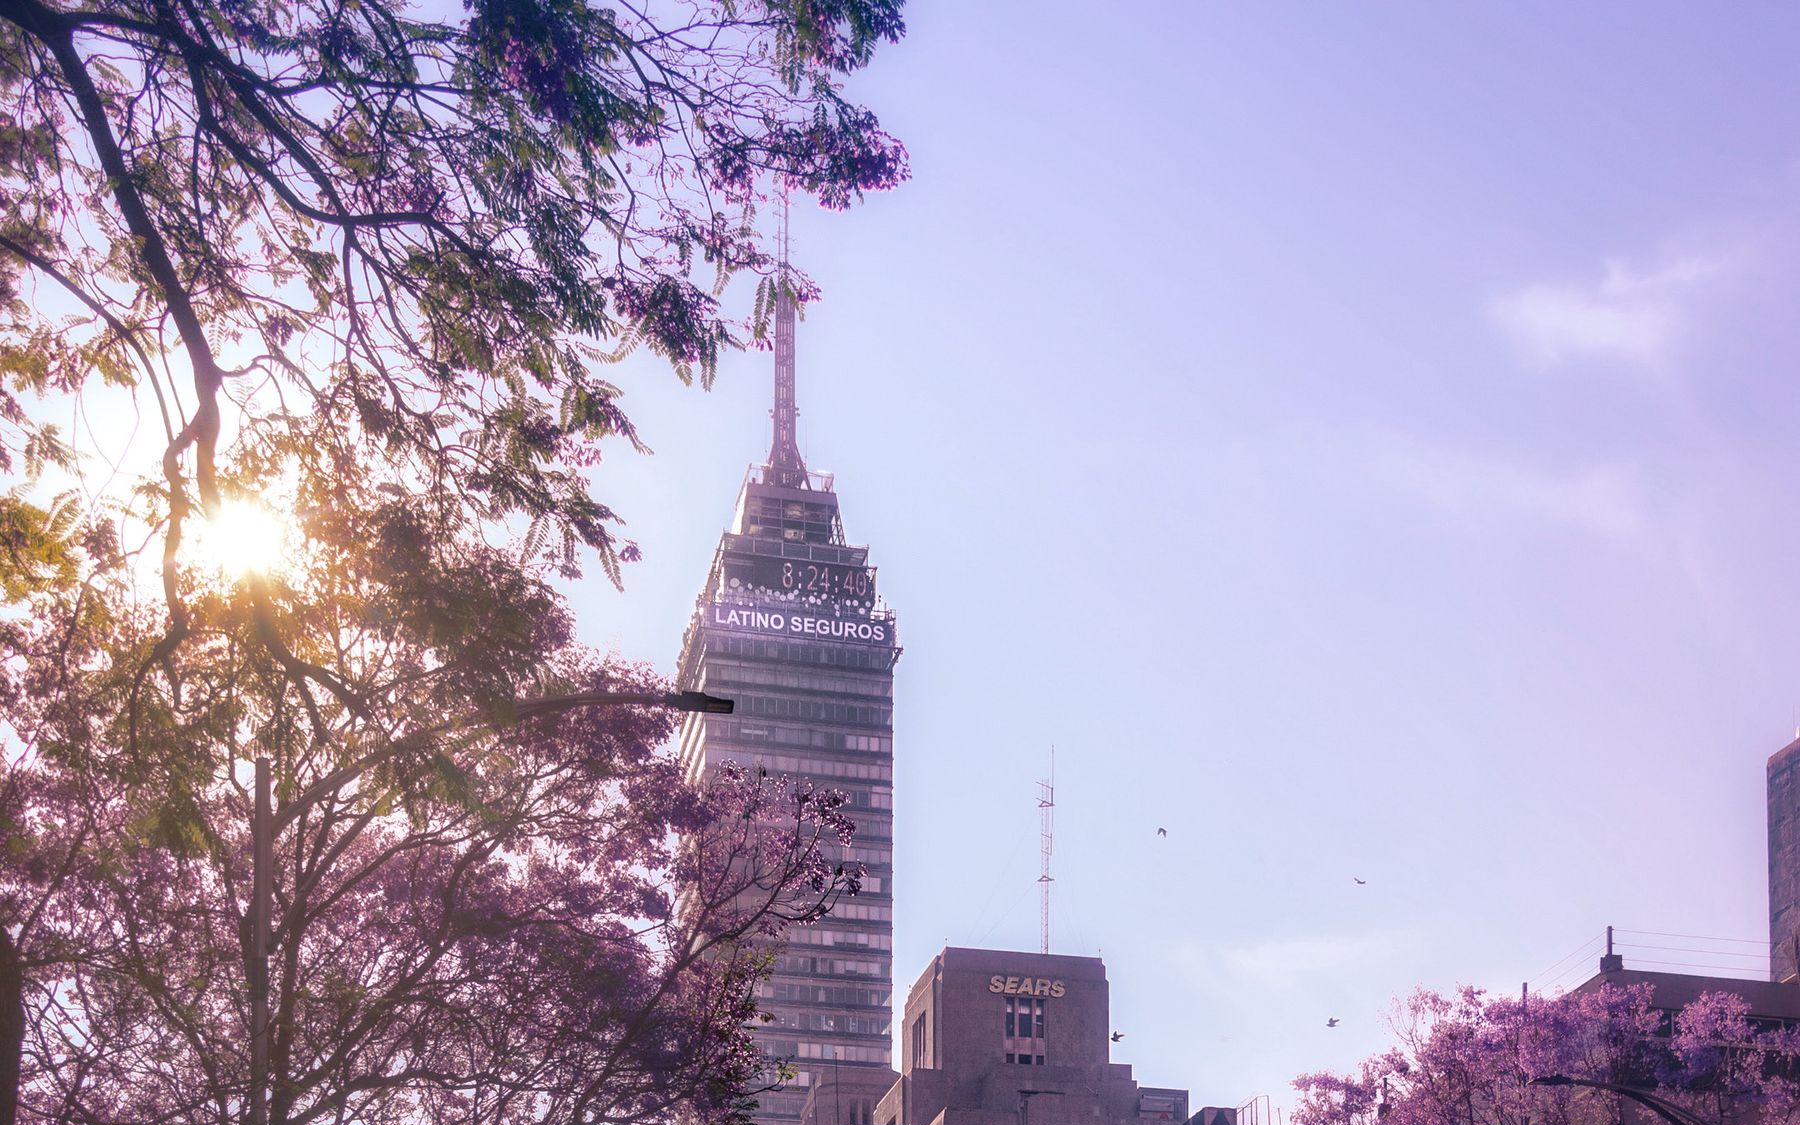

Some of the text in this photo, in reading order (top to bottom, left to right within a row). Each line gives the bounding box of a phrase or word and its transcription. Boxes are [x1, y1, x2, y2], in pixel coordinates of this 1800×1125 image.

[715, 607, 885, 641] LATINO SEGUROS
[988, 974, 1066, 998] SEARS
